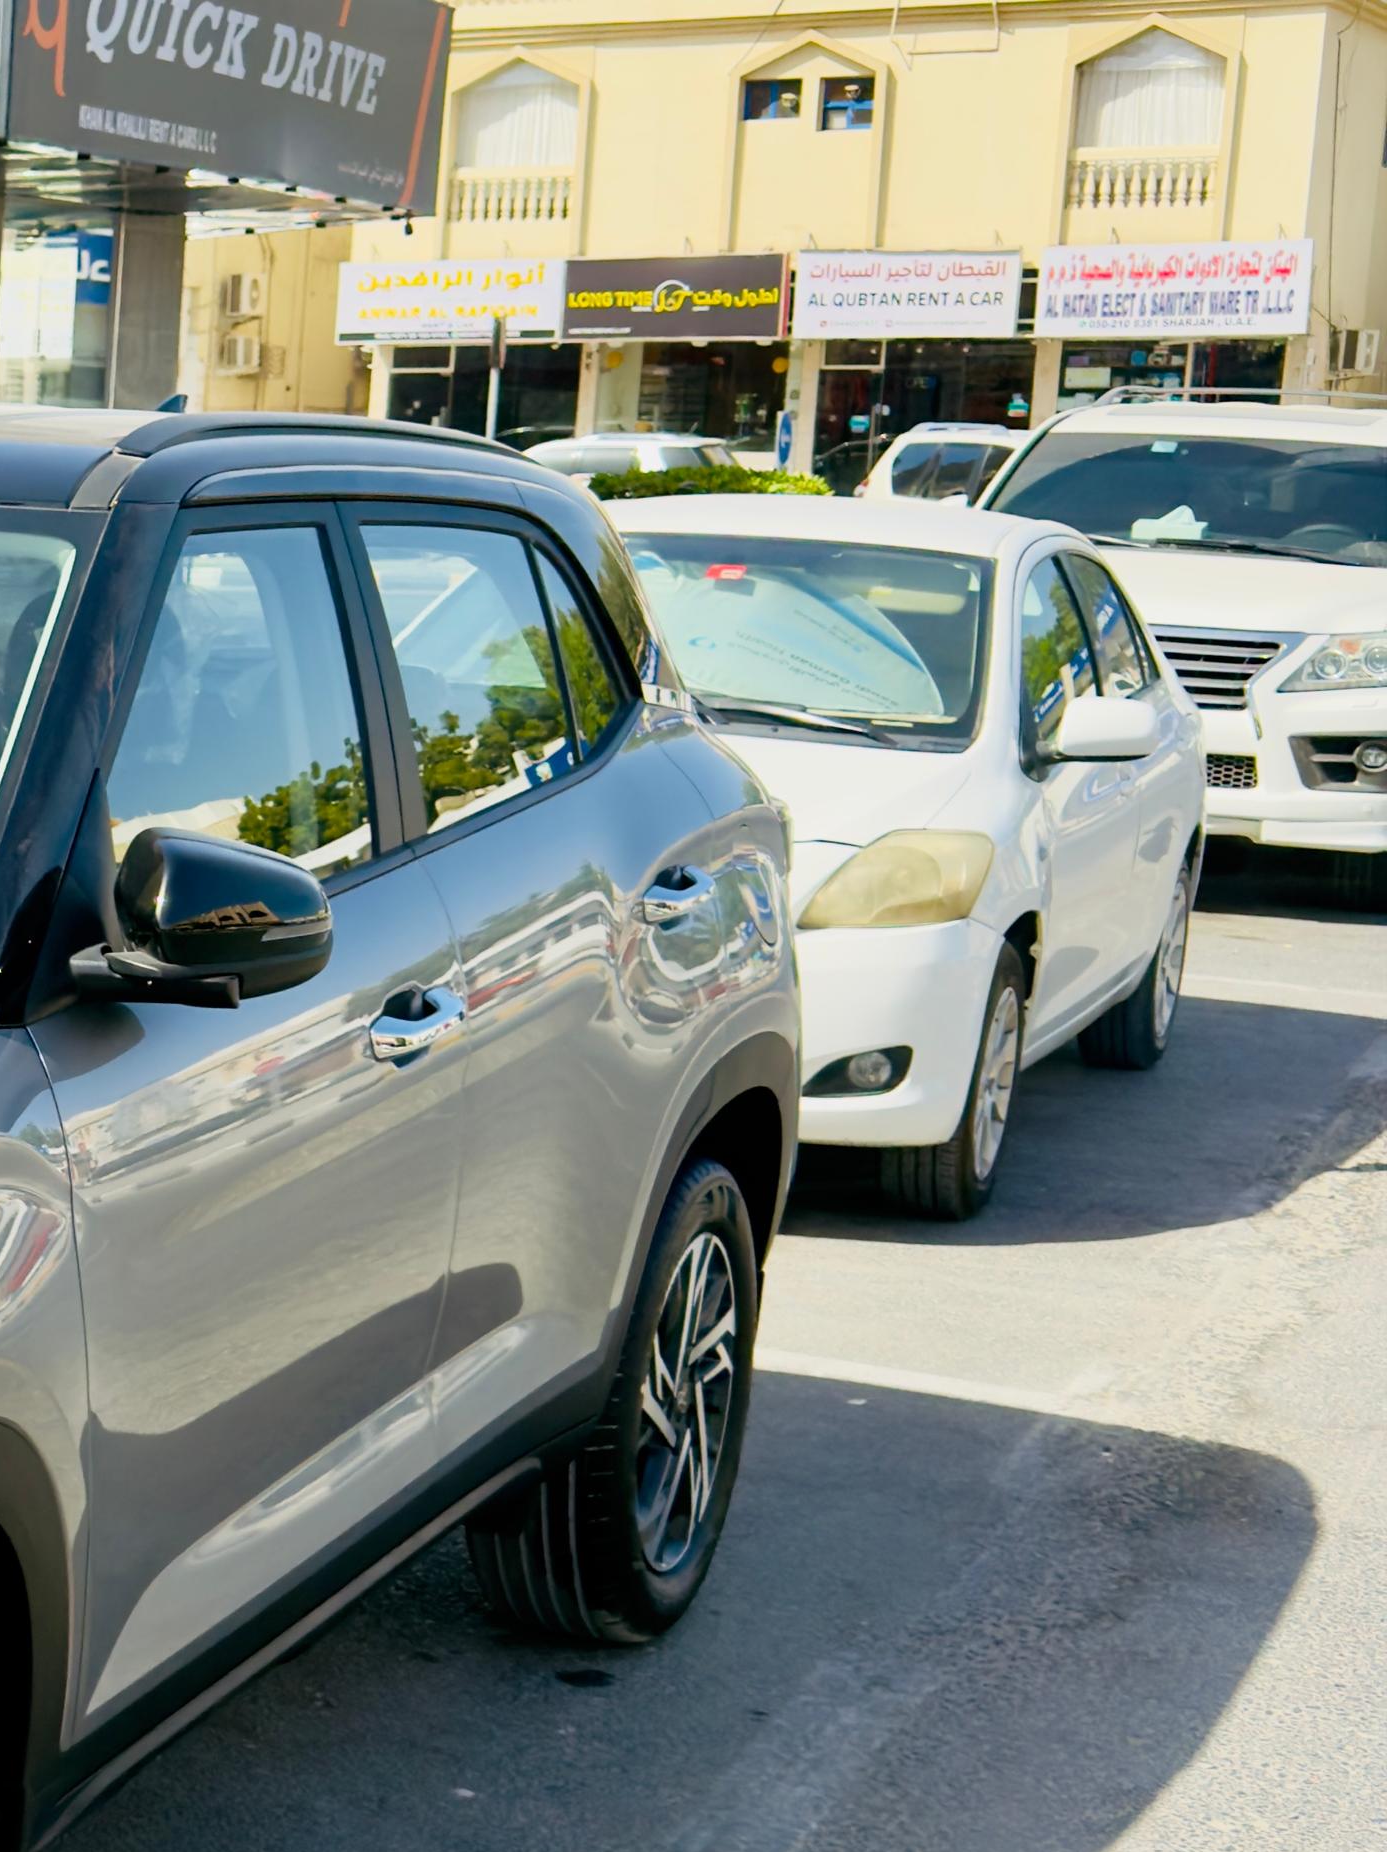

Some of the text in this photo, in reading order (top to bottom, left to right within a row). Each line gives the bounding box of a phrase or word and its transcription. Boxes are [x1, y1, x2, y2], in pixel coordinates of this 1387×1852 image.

[85, 0, 387, 116] QUICK DRIVE
[568, 289, 653, 309] LONG TIME
[807, 291, 1004, 308] AL QUBTAN RENT A CAR
[1101, 292, 1136, 318] ELECT
